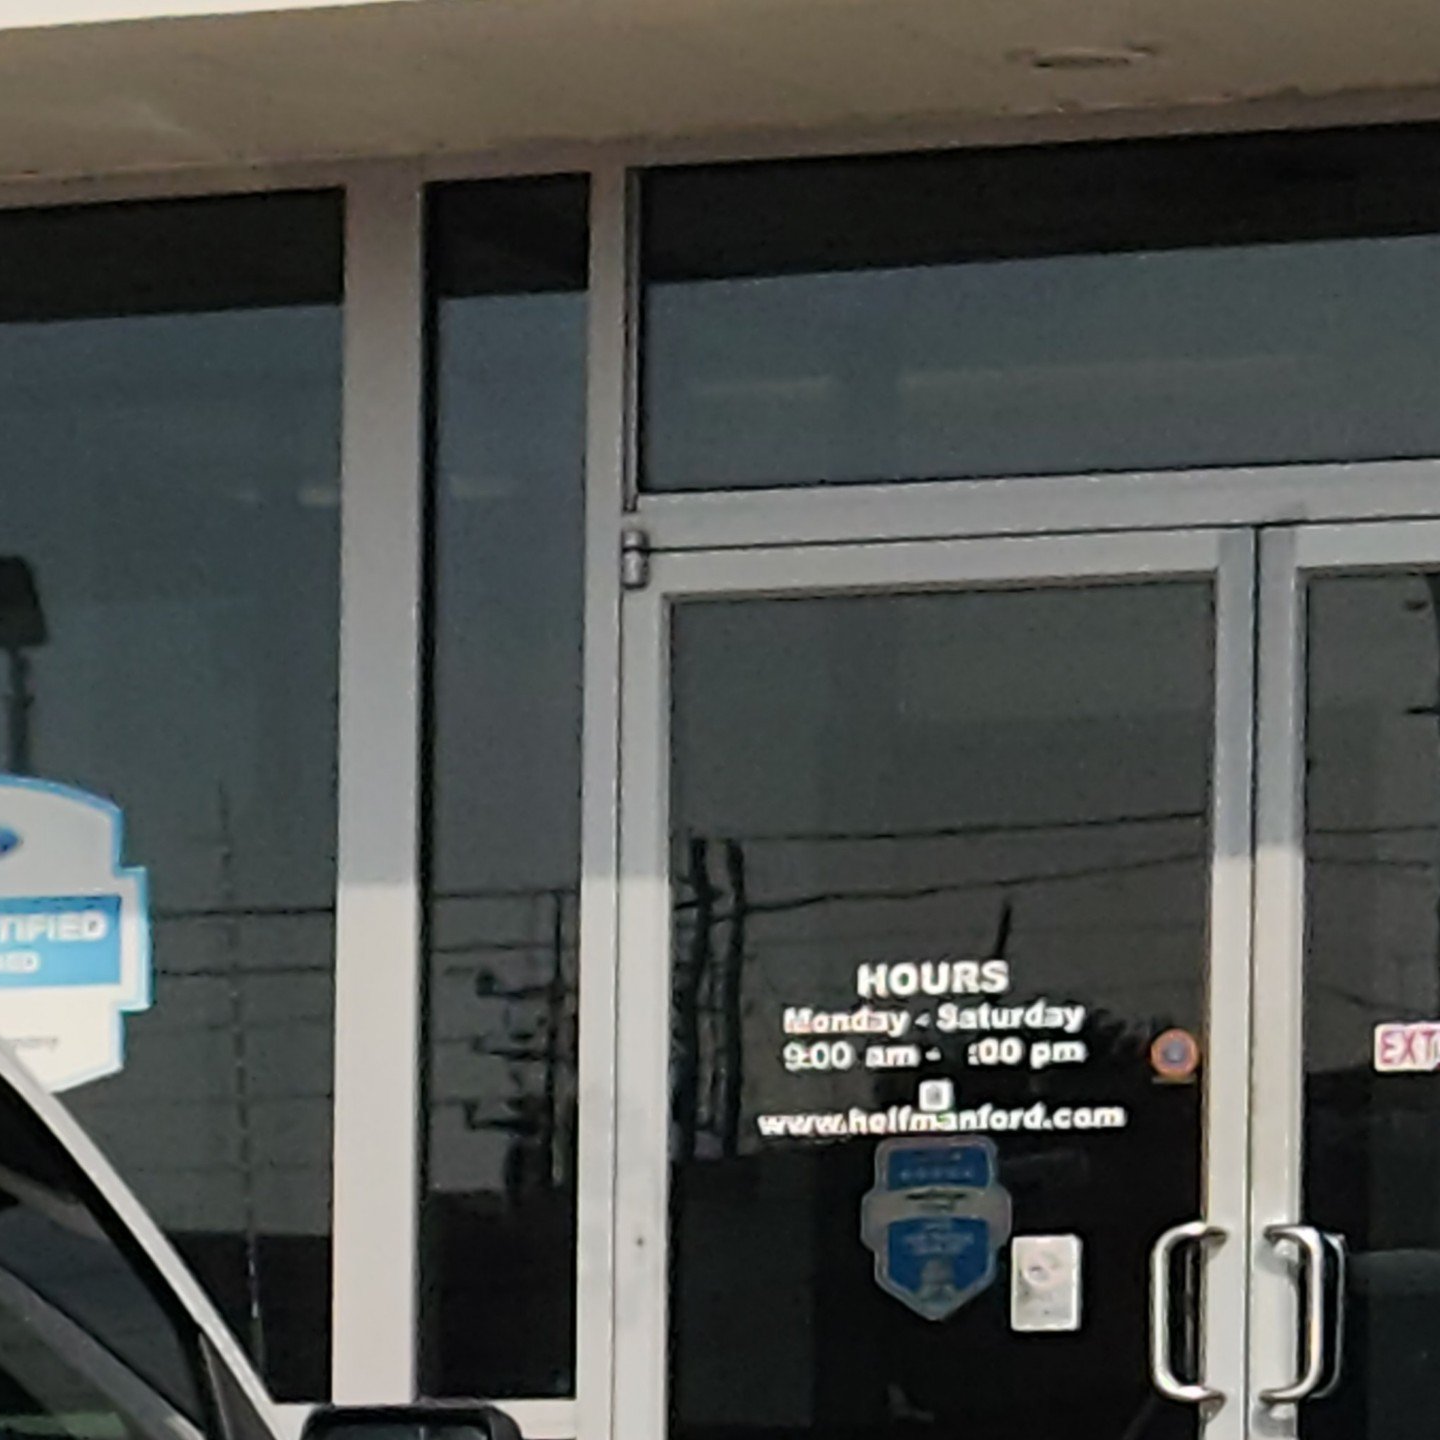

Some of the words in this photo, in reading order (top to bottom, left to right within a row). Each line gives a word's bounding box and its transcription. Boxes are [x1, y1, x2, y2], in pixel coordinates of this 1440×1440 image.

[857, 960, 1009, 996] HOURS
[783, 1007, 909, 1037] Monday
[935, 1000, 1085, 1032] Saturday
[783, 1042, 854, 1071] 9:00
[865, 1046, 920, 1068] am
[1030, 1041, 1086, 1069] pm
